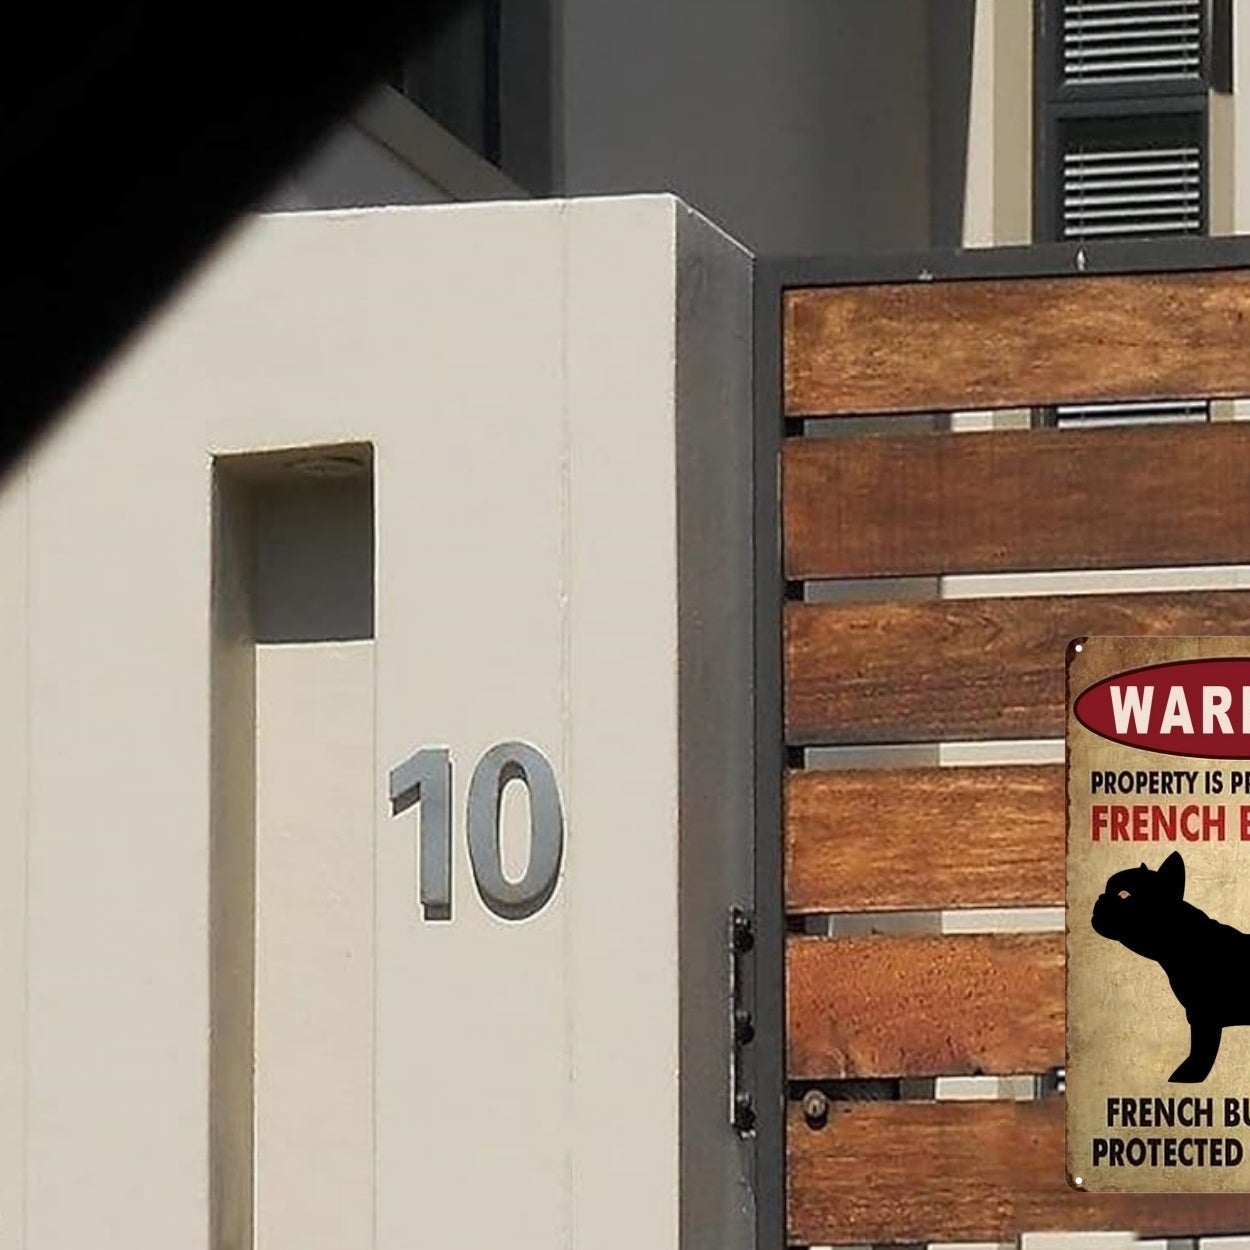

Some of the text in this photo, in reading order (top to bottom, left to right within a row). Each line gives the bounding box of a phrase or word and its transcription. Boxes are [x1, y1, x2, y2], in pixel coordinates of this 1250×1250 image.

[1091, 771, 1199, 795] PROPERTY
[1205, 771, 1223, 795] IS
[389, 741, 564, 921] 10
[1092, 805, 1225, 842] FRENCH
[1106, 1097, 1213, 1127] FRENCH
[1092, 1138, 1243, 1167] PROTECTED
